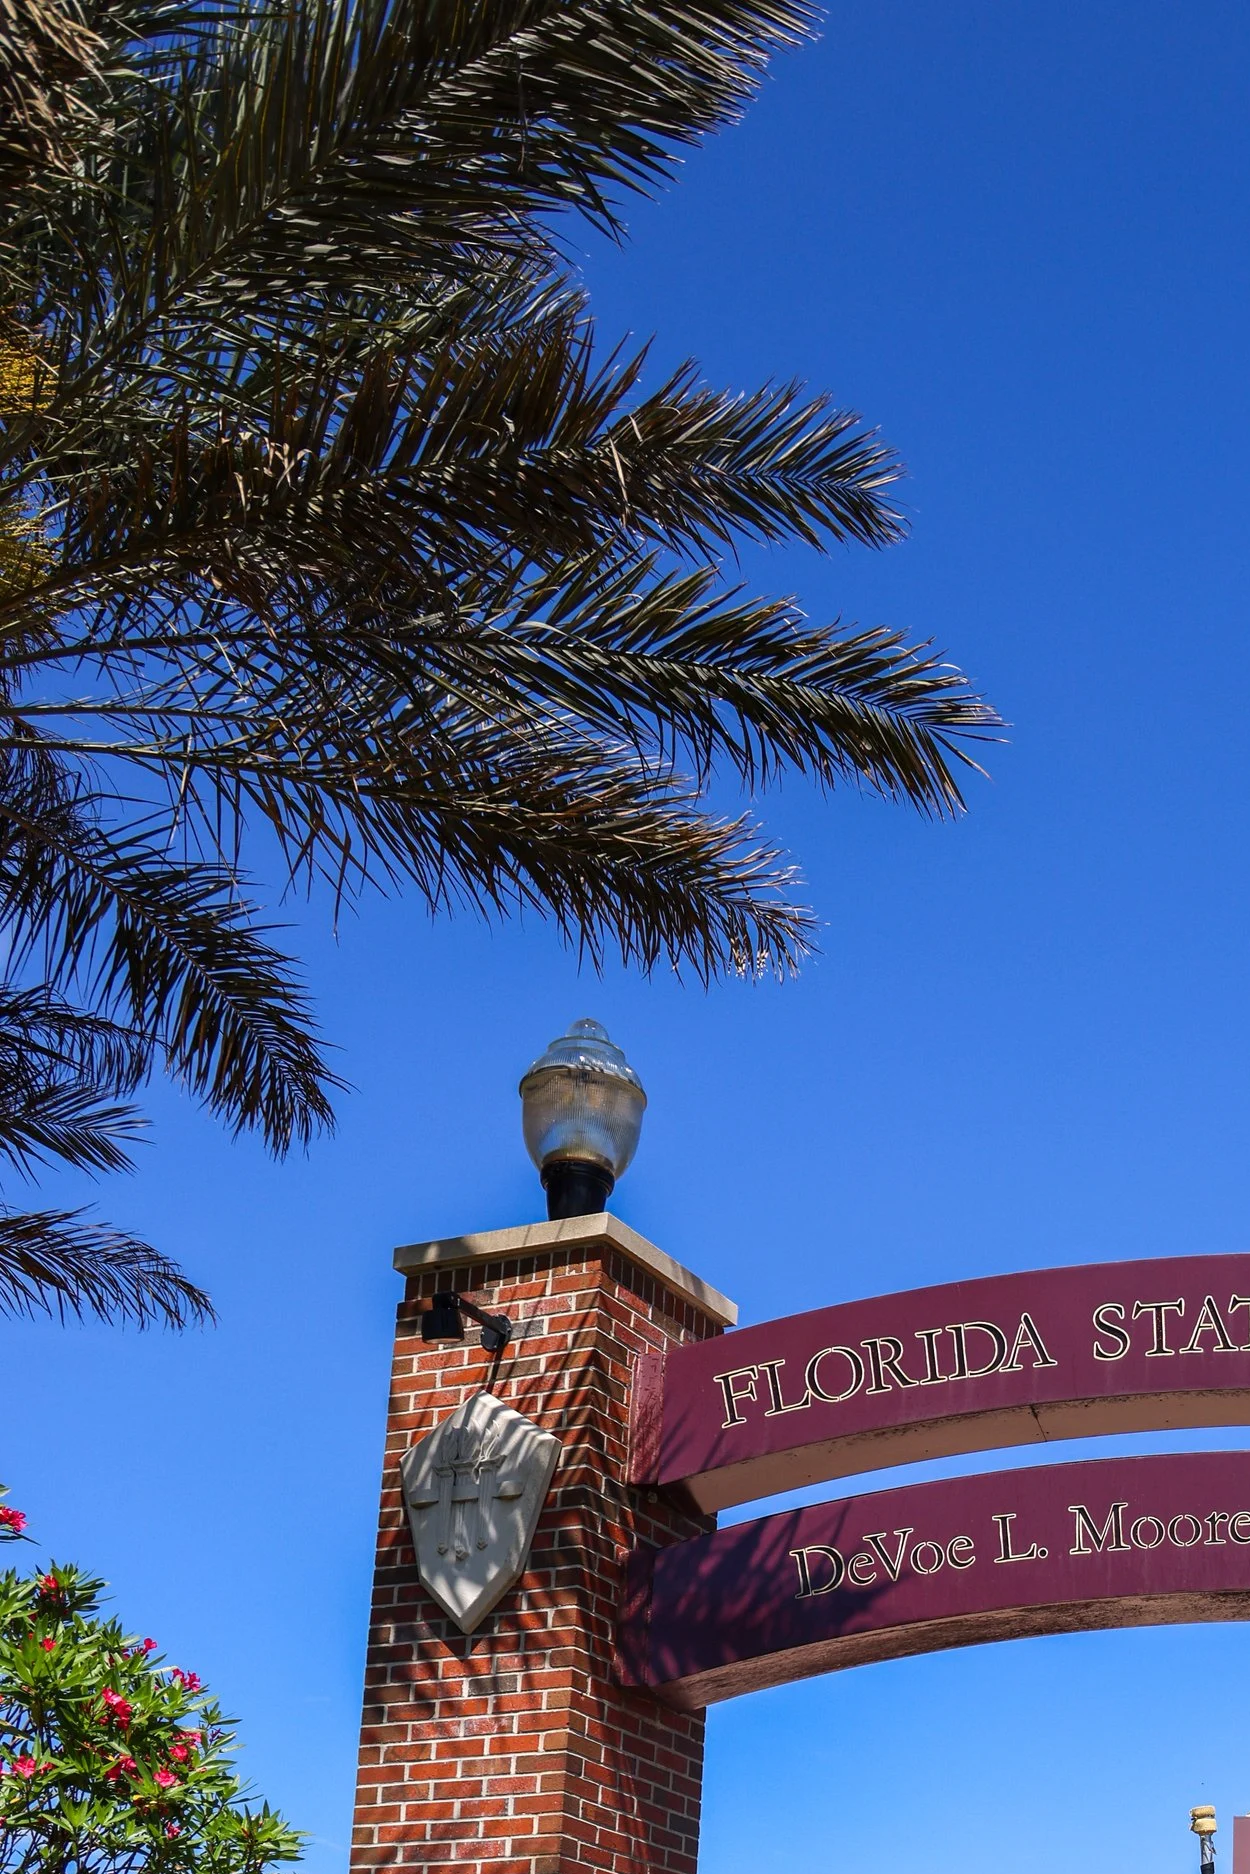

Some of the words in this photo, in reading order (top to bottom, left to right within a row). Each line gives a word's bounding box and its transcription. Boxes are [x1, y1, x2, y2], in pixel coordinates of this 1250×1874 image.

[713, 1312, 1057, 1428] FLORIDA
[789, 1527, 975, 1598] DeVoe
[992, 1514, 1048, 1564] L.
